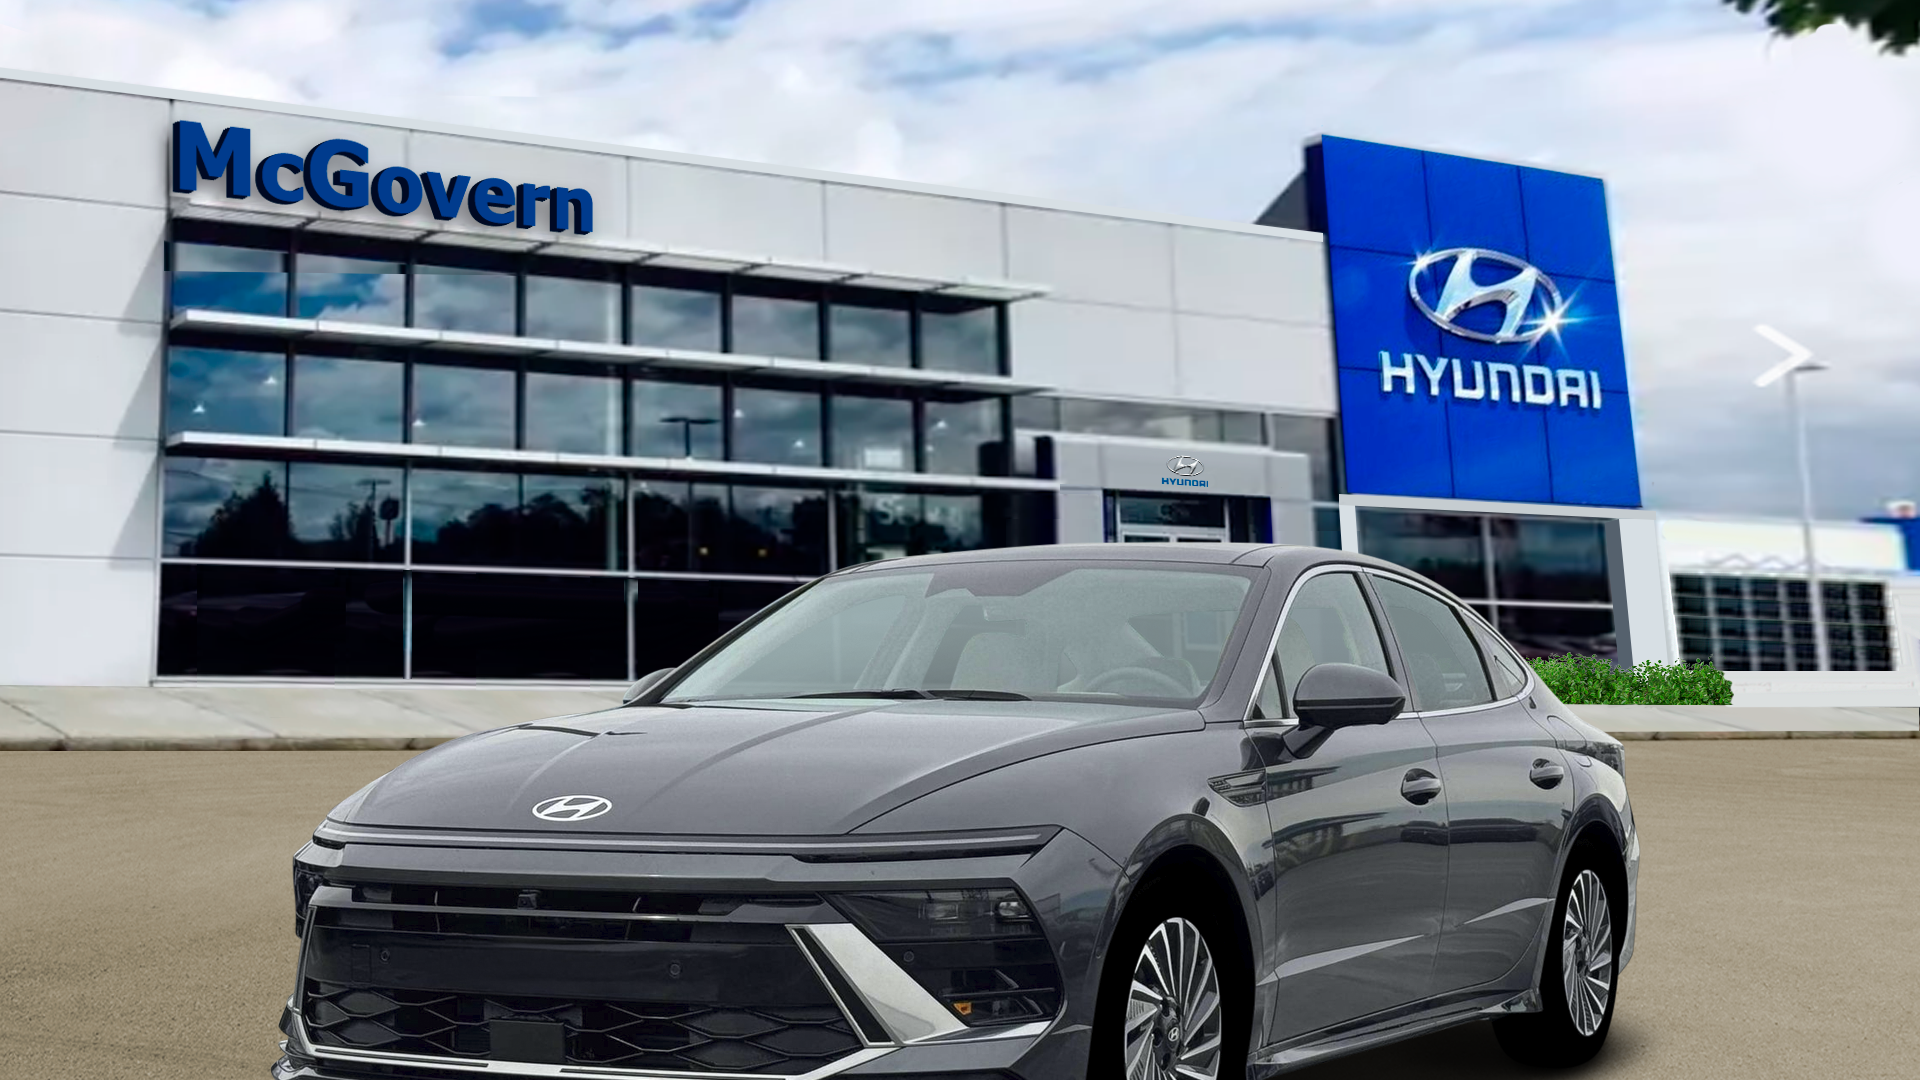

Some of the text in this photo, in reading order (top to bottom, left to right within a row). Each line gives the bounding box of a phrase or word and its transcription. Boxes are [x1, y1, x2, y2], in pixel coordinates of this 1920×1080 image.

[172, 120, 594, 235] McGovern
[1378, 350, 1602, 409] HYUNDAI
[1161, 477, 1209, 488] HYUNDAI
